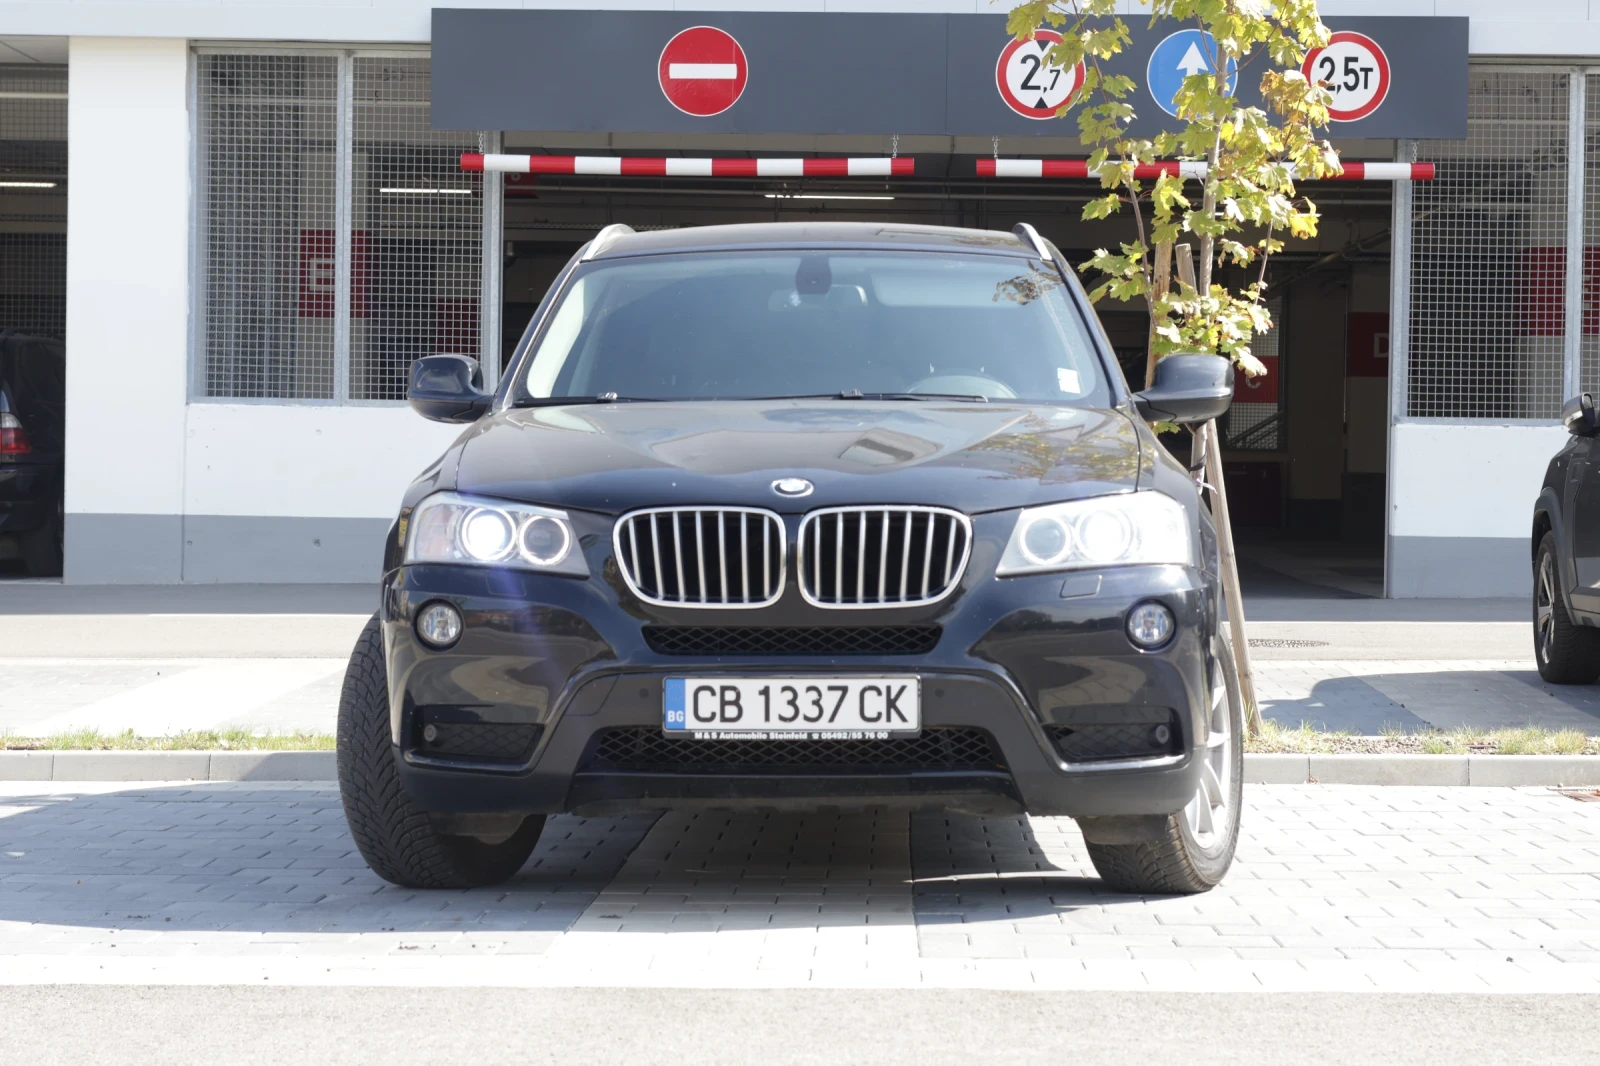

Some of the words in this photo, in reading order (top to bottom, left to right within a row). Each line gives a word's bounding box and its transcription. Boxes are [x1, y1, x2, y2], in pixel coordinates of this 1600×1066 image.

[693, 685, 743, 723] CB
[758, 685, 849, 723] 1337
[859, 685, 908, 723] CK
[667, 710, 684, 723] BG
[694, 732, 703, 740] M
[703, 732, 711, 740] &
[711, 732, 718, 740] S
[719, 732, 768, 740] Automobile
[769, 732, 808, 740] Steinfeld
[877, 732, 889, 740] 00
